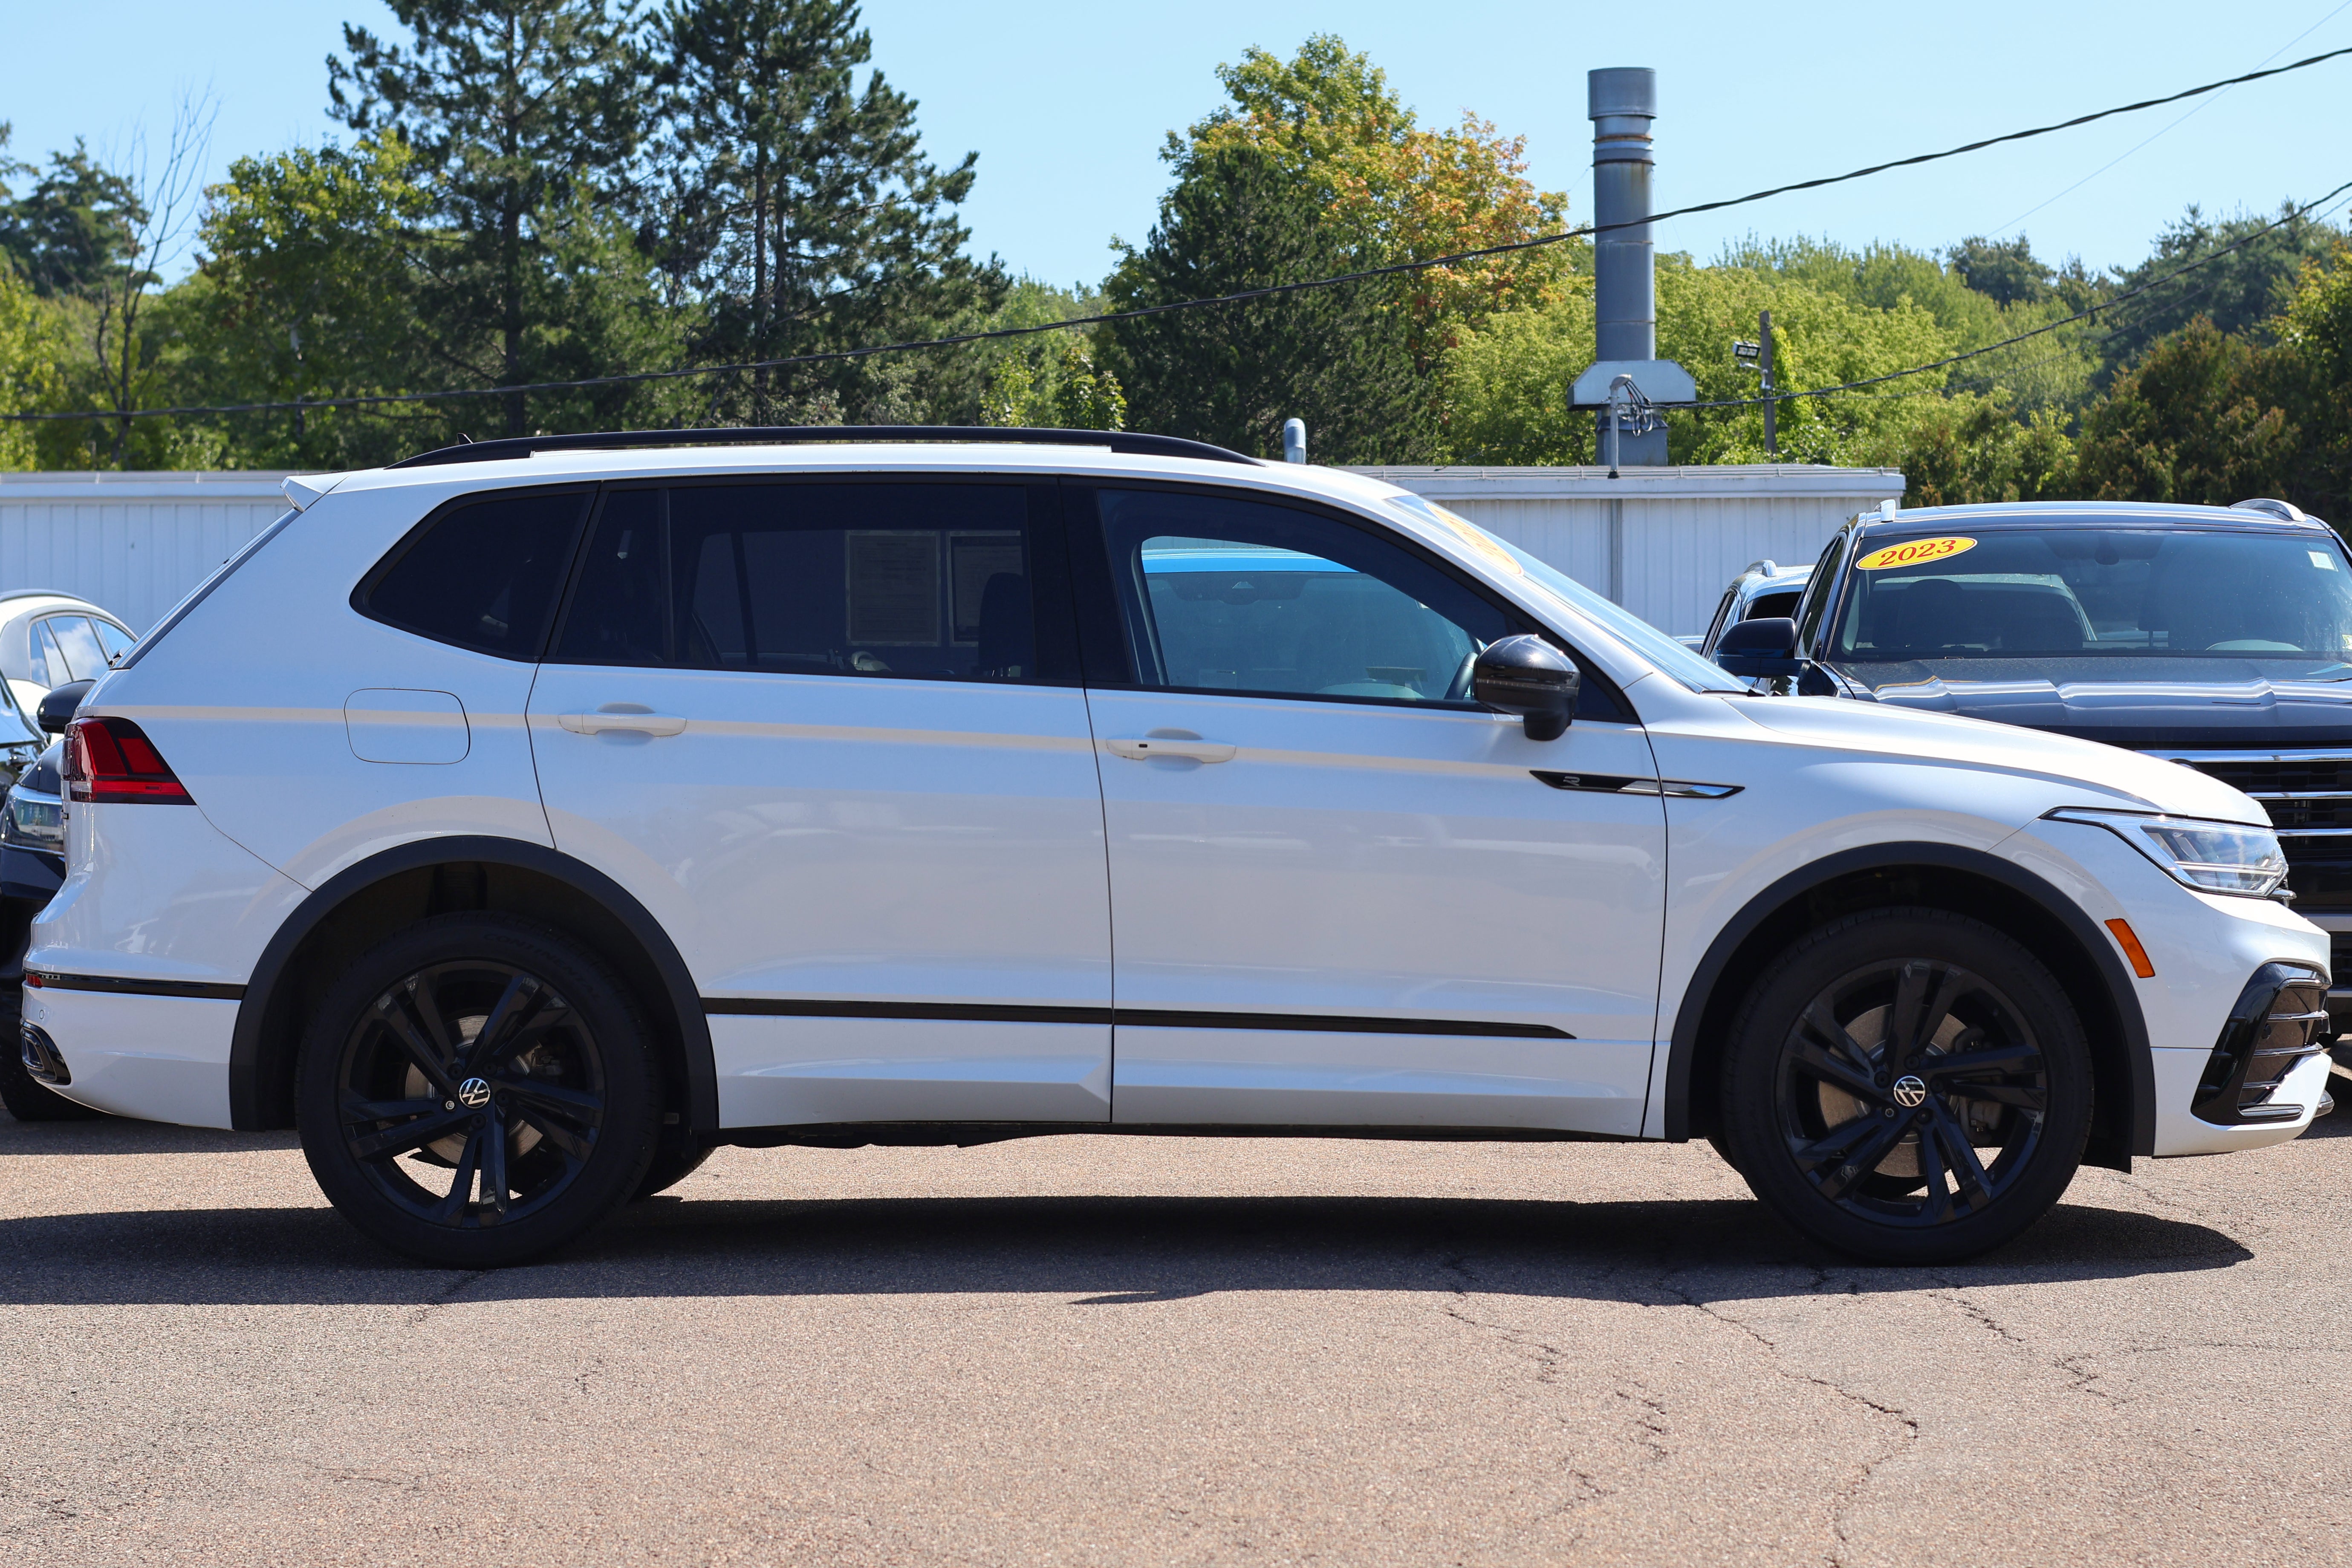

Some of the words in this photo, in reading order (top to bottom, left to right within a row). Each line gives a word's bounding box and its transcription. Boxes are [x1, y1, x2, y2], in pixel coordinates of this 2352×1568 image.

[1878, 540, 1956, 566] 2023
[1563, 776, 1580, 786] R
[484, 933, 601, 1002] CONTINENTAL
[459, 1077, 491, 1109] VW
[1893, 1075, 1926, 1107] VW
